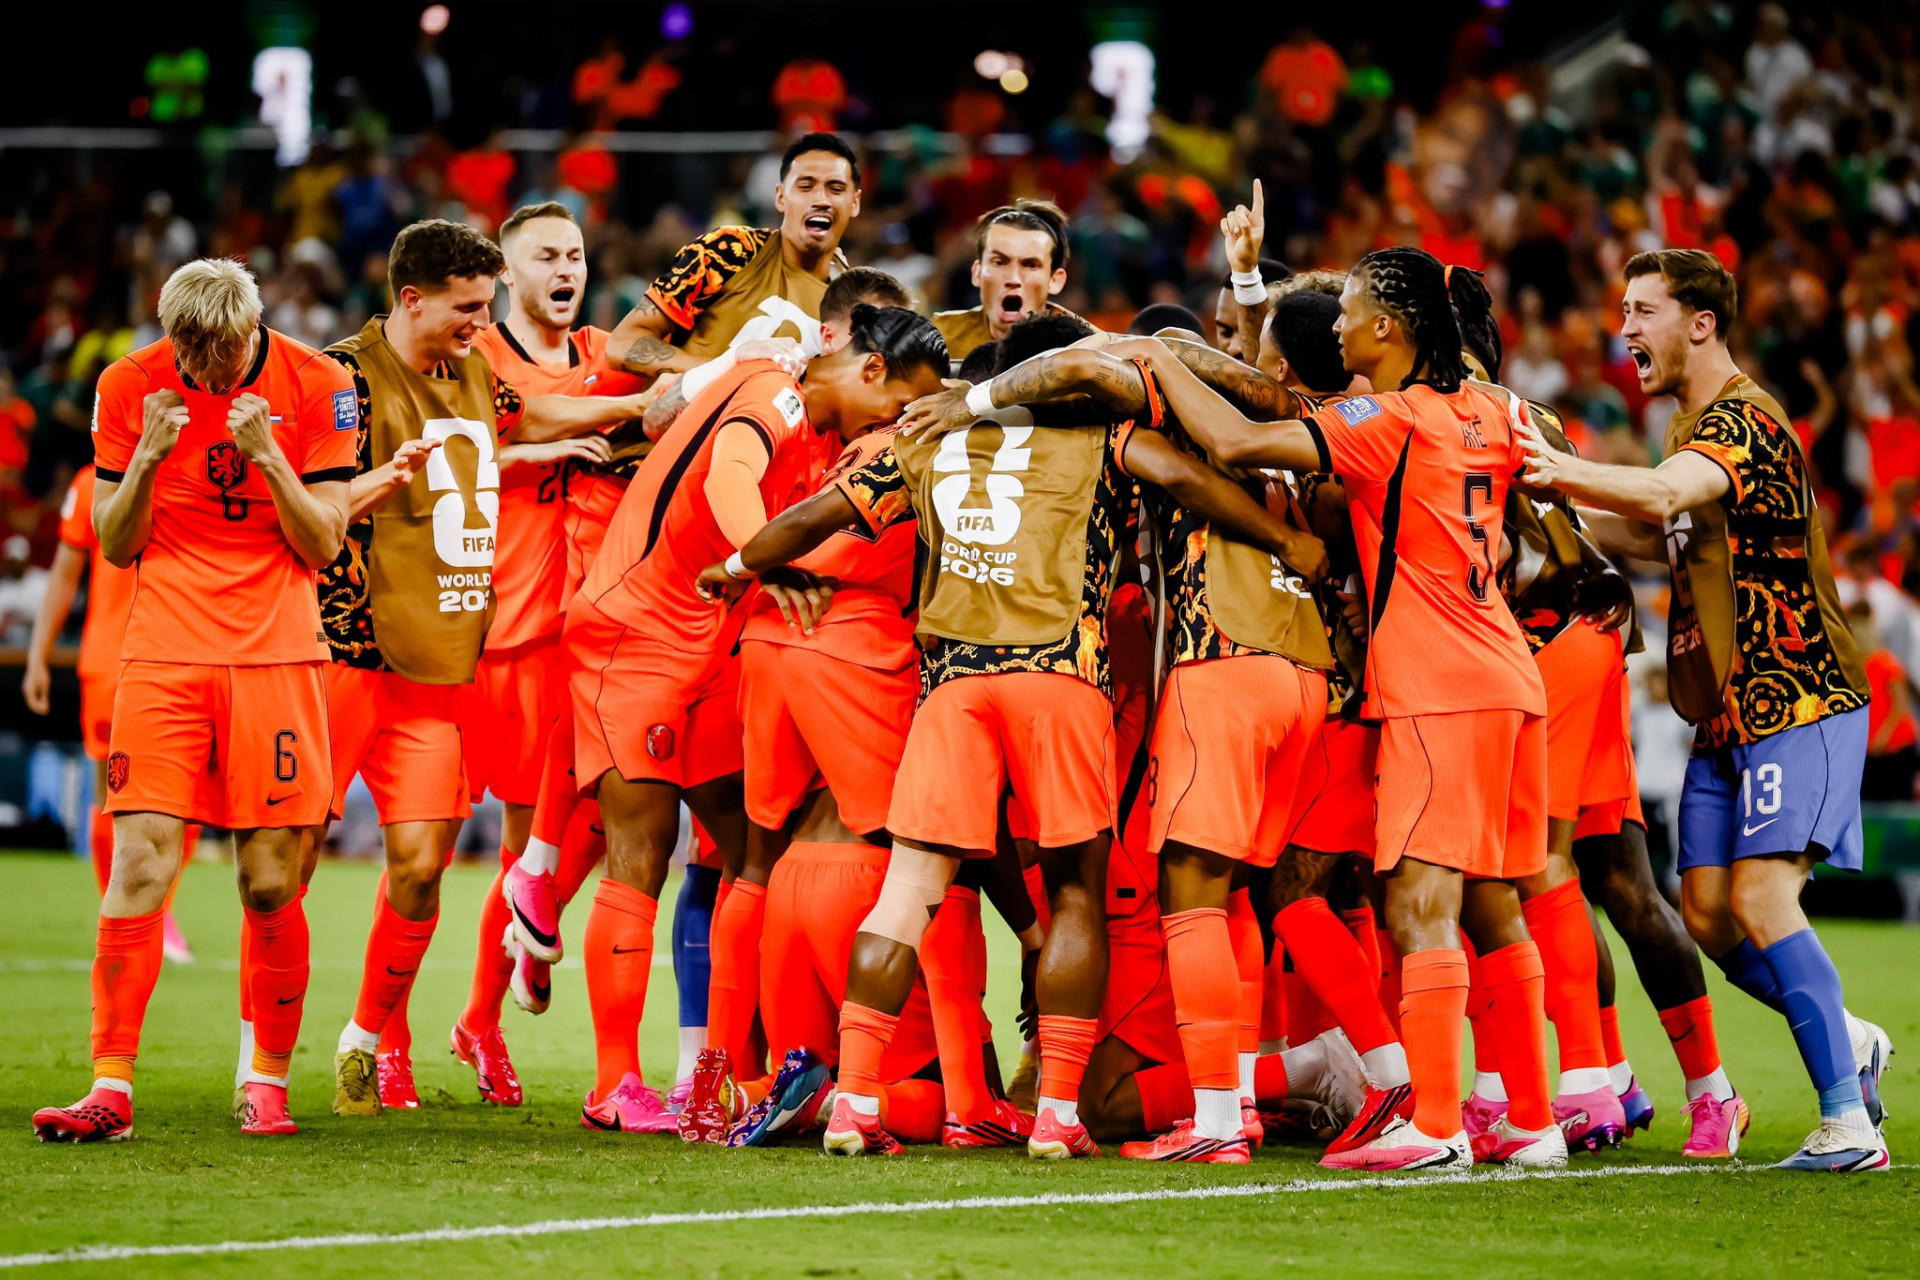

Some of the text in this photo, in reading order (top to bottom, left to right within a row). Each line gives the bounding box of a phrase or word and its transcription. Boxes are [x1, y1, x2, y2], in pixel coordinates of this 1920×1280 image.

[957, 515, 995, 532] FIFA
[462, 536, 495, 552] FIFA
[1462, 472, 1493, 602] 5
[983, 551, 1017, 565] CUP
[437, 573, 491, 588] WORLD
[274, 729, 297, 783] 6
[1742, 763, 1783, 818] 13
